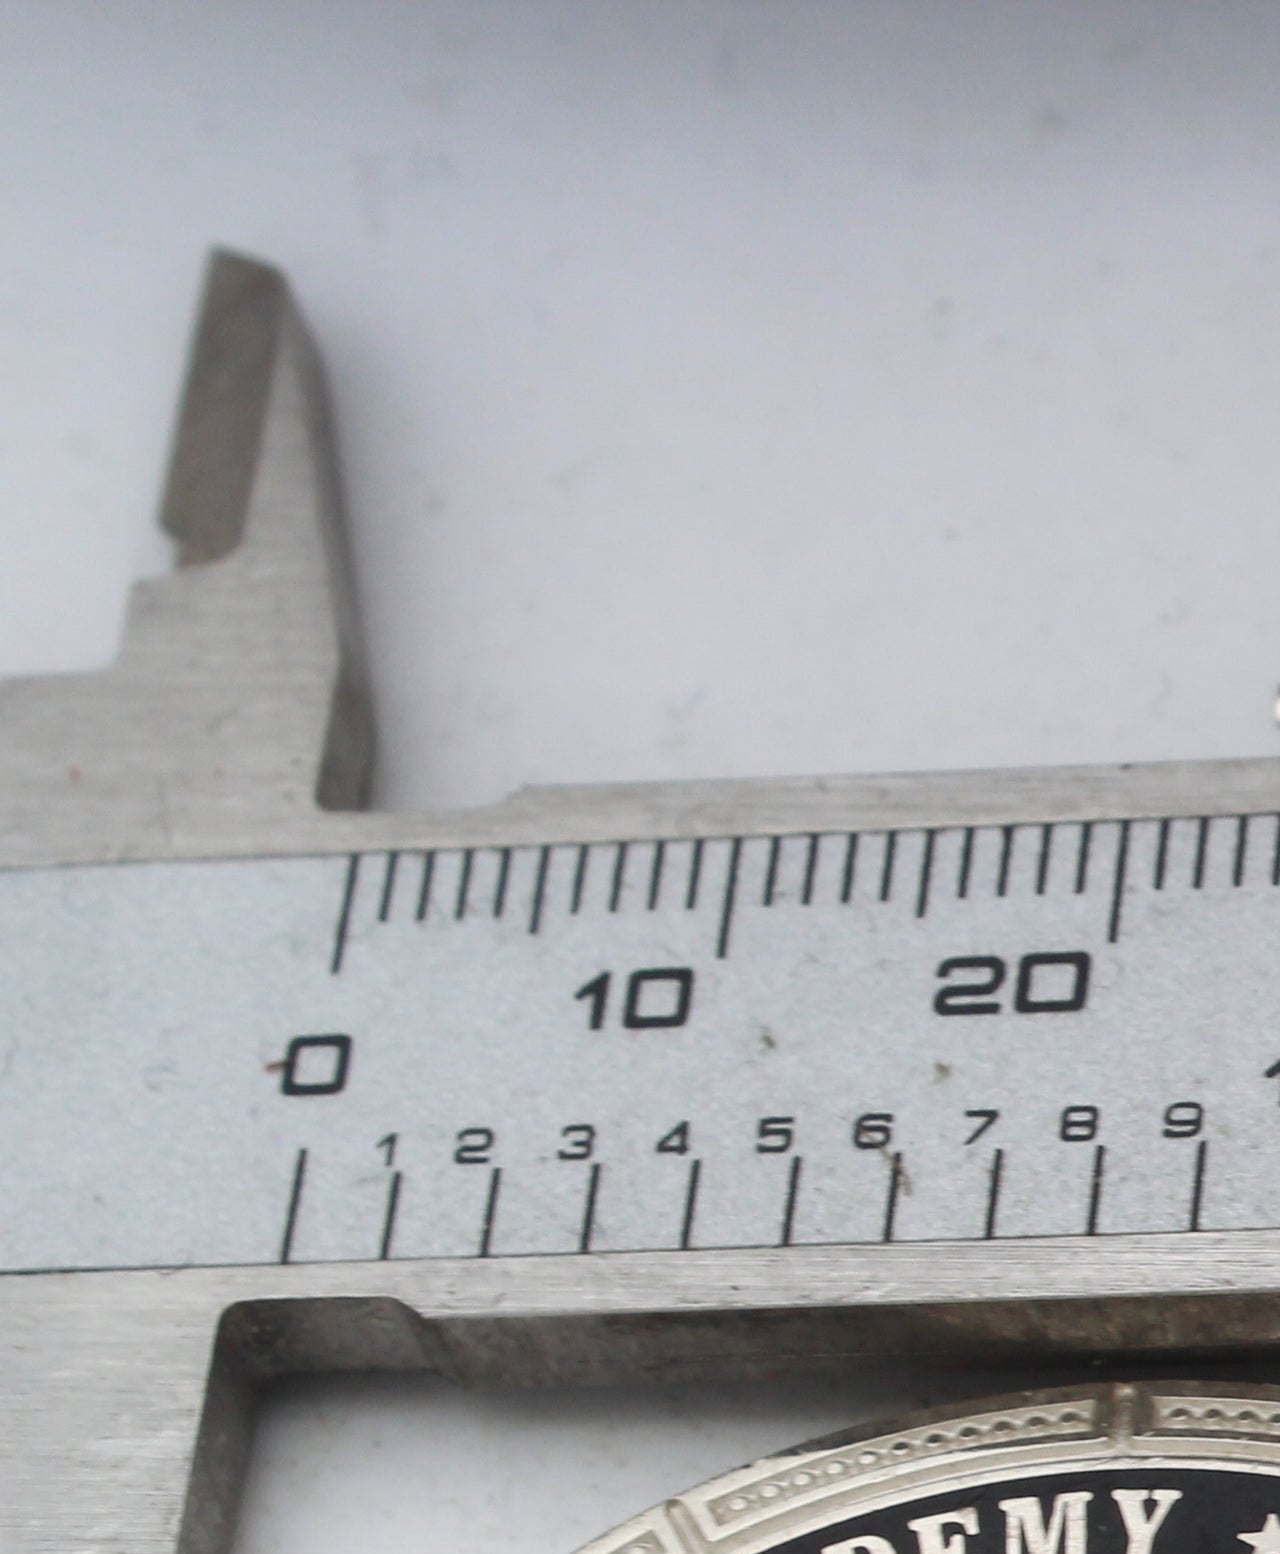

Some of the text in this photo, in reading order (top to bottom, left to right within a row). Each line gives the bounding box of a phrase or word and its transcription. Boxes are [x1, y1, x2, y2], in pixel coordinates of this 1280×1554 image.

[281, 1033, 353, 1097] 0
[574, 965, 696, 1030] 10
[932, 950, 1092, 1015] 20
[378, 1132, 399, 1167] 1
[453, 1127, 495, 1165] 2
[556, 1124, 596, 1161] 3
[655, 1120, 692, 1155] 4
[755, 1115, 796, 1154] 5
[852, 1112, 895, 1150] 6
[962, 1109, 1000, 1146] 7
[1058, 1105, 1102, 1143] 8
[1161, 1101, 1204, 1139] 9
